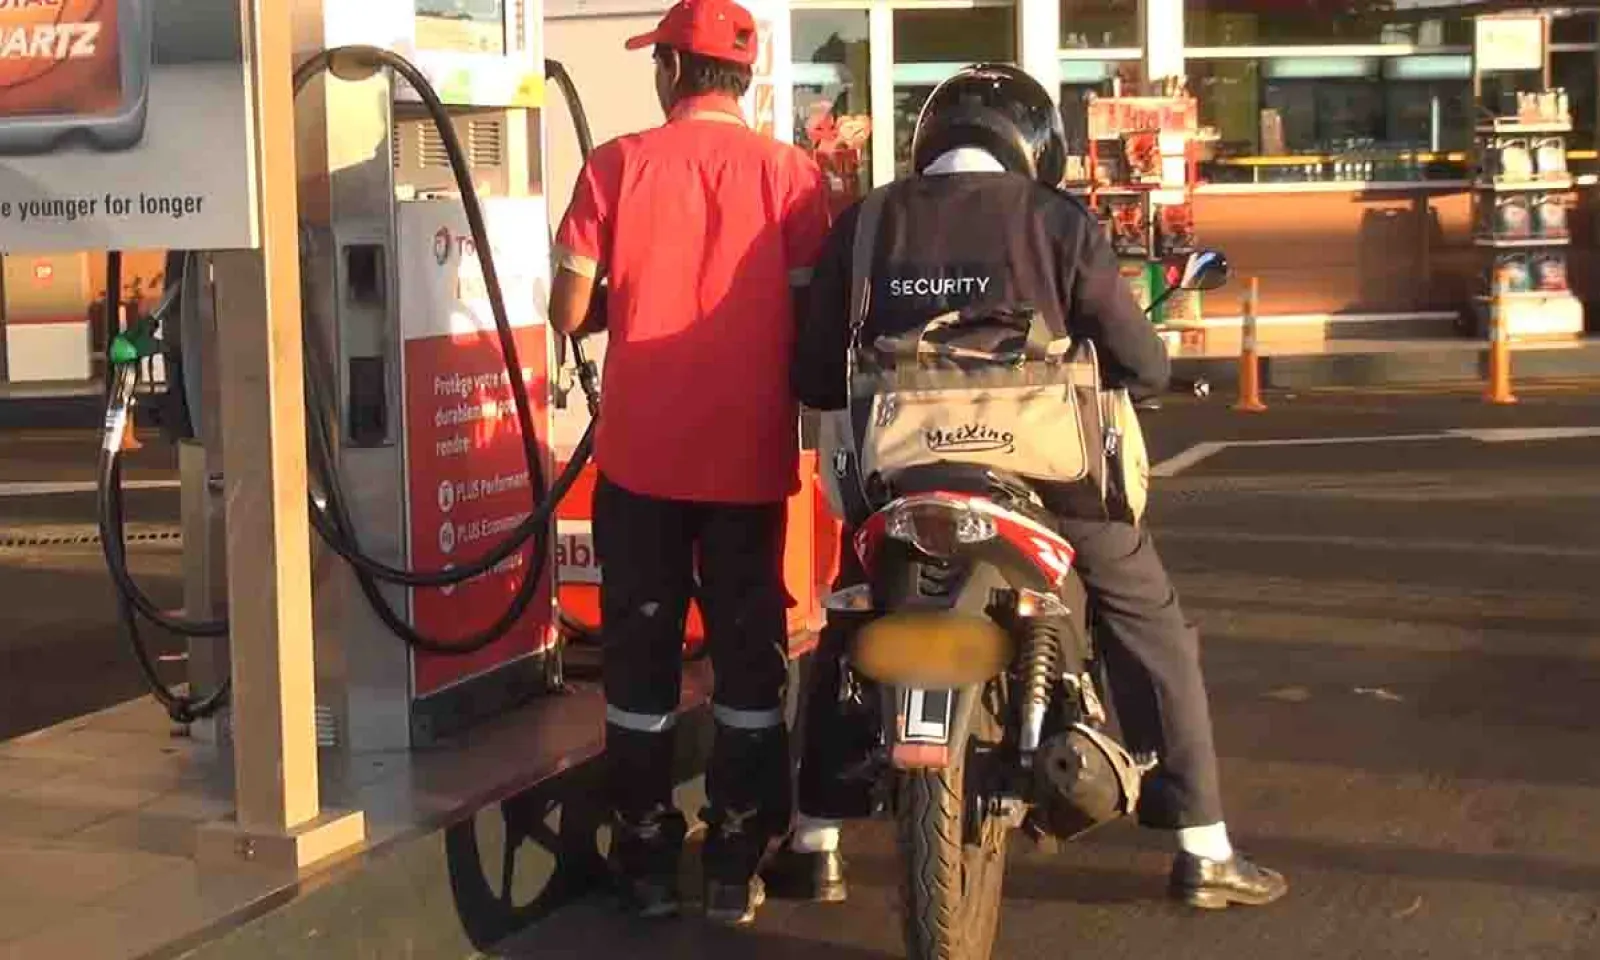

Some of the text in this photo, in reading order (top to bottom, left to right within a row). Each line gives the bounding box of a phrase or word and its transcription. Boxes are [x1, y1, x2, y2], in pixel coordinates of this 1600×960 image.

[0, 21, 101, 60] ARTZ
[19, 198, 98, 221] younger
[105, 193, 132, 214] for
[140, 191, 204, 218] longer
[889, 276, 990, 296] SECURITY
[908, 688, 944, 736] L
